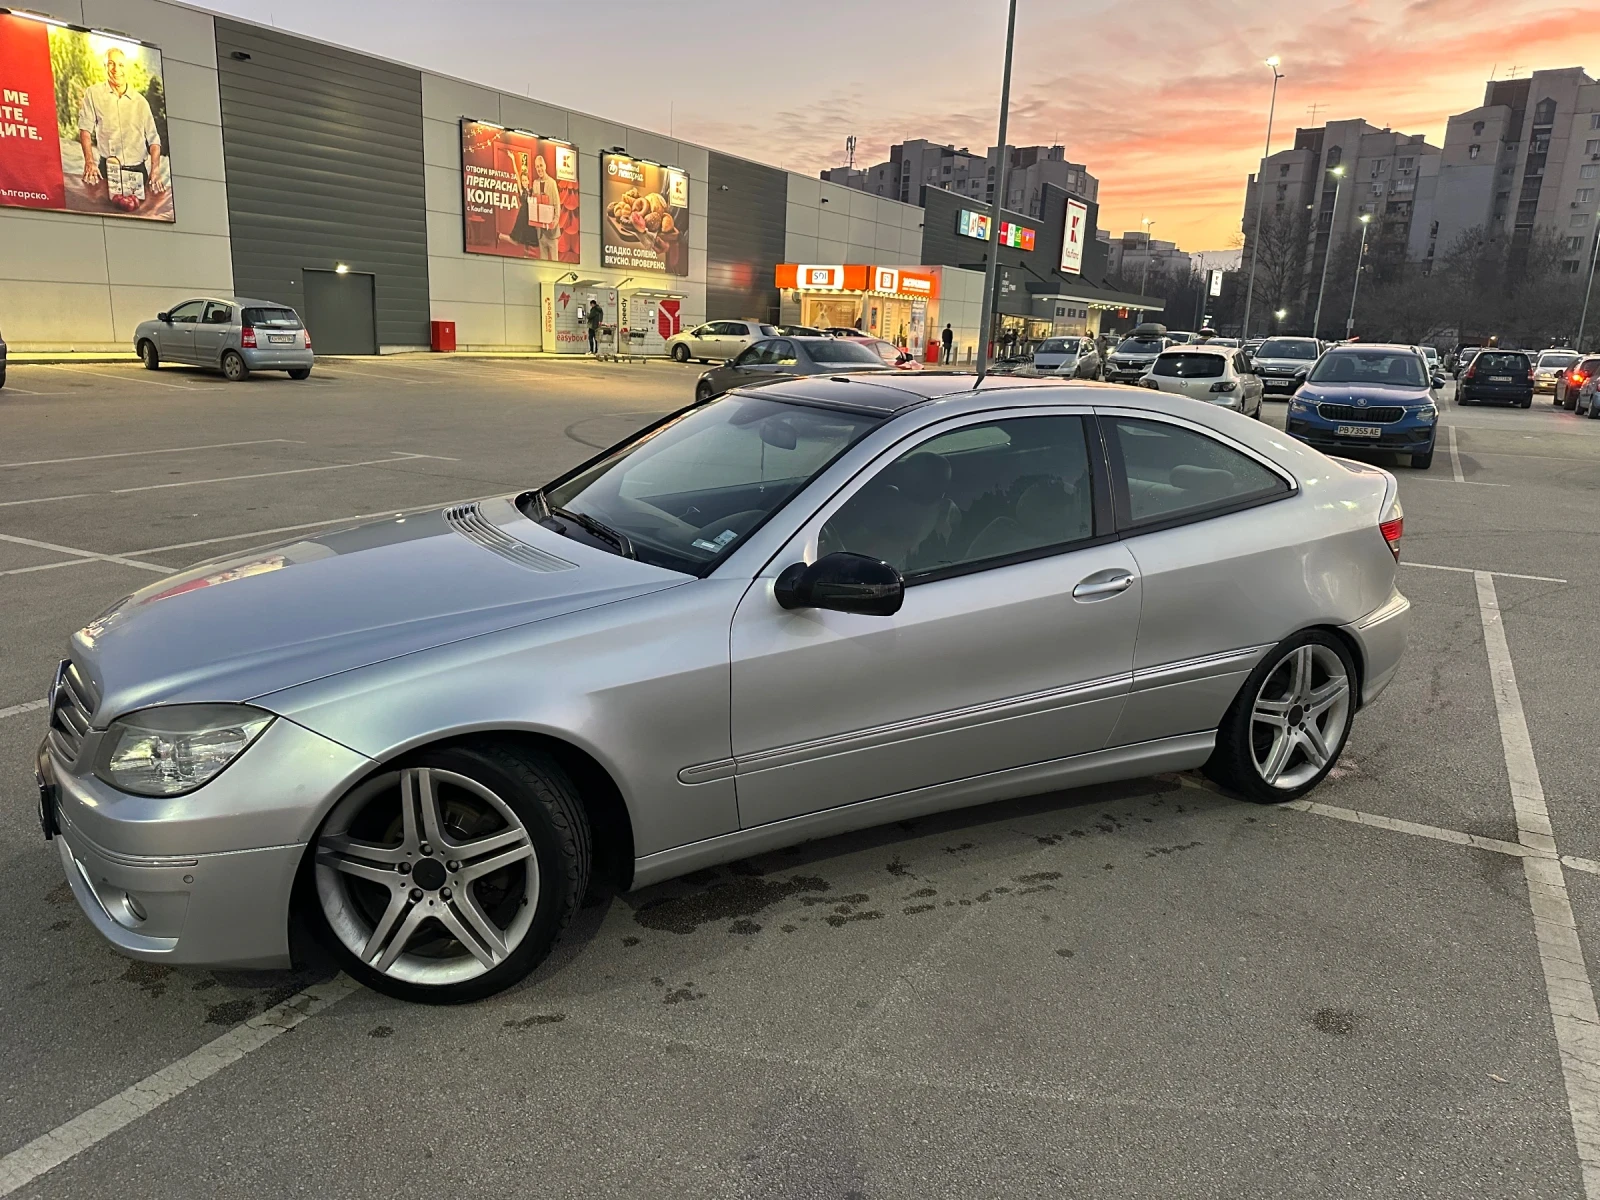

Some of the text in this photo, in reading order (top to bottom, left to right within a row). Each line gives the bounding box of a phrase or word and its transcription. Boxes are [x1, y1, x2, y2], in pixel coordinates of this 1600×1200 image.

[3, 89, 30, 106] МЕ
[0, 105, 28, 124] ТЕ,
[465, 165, 488, 175] ОТВОРИ
[488, 169, 510, 179] ВРАТАТА
[466, 174, 519, 194] ПРЕКРАСНА
[0, 188, 50, 201] ългарско.
[466, 187, 519, 210] КОЛЕДА
[604, 244, 632, 257] СЛАДКО.
[604, 255, 666, 270] ВКУСНО. ПРОВЕРЕНО.
[557, 333, 584, 343] easybox
[1339, 426, 1380, 436] PB 7355 AE
